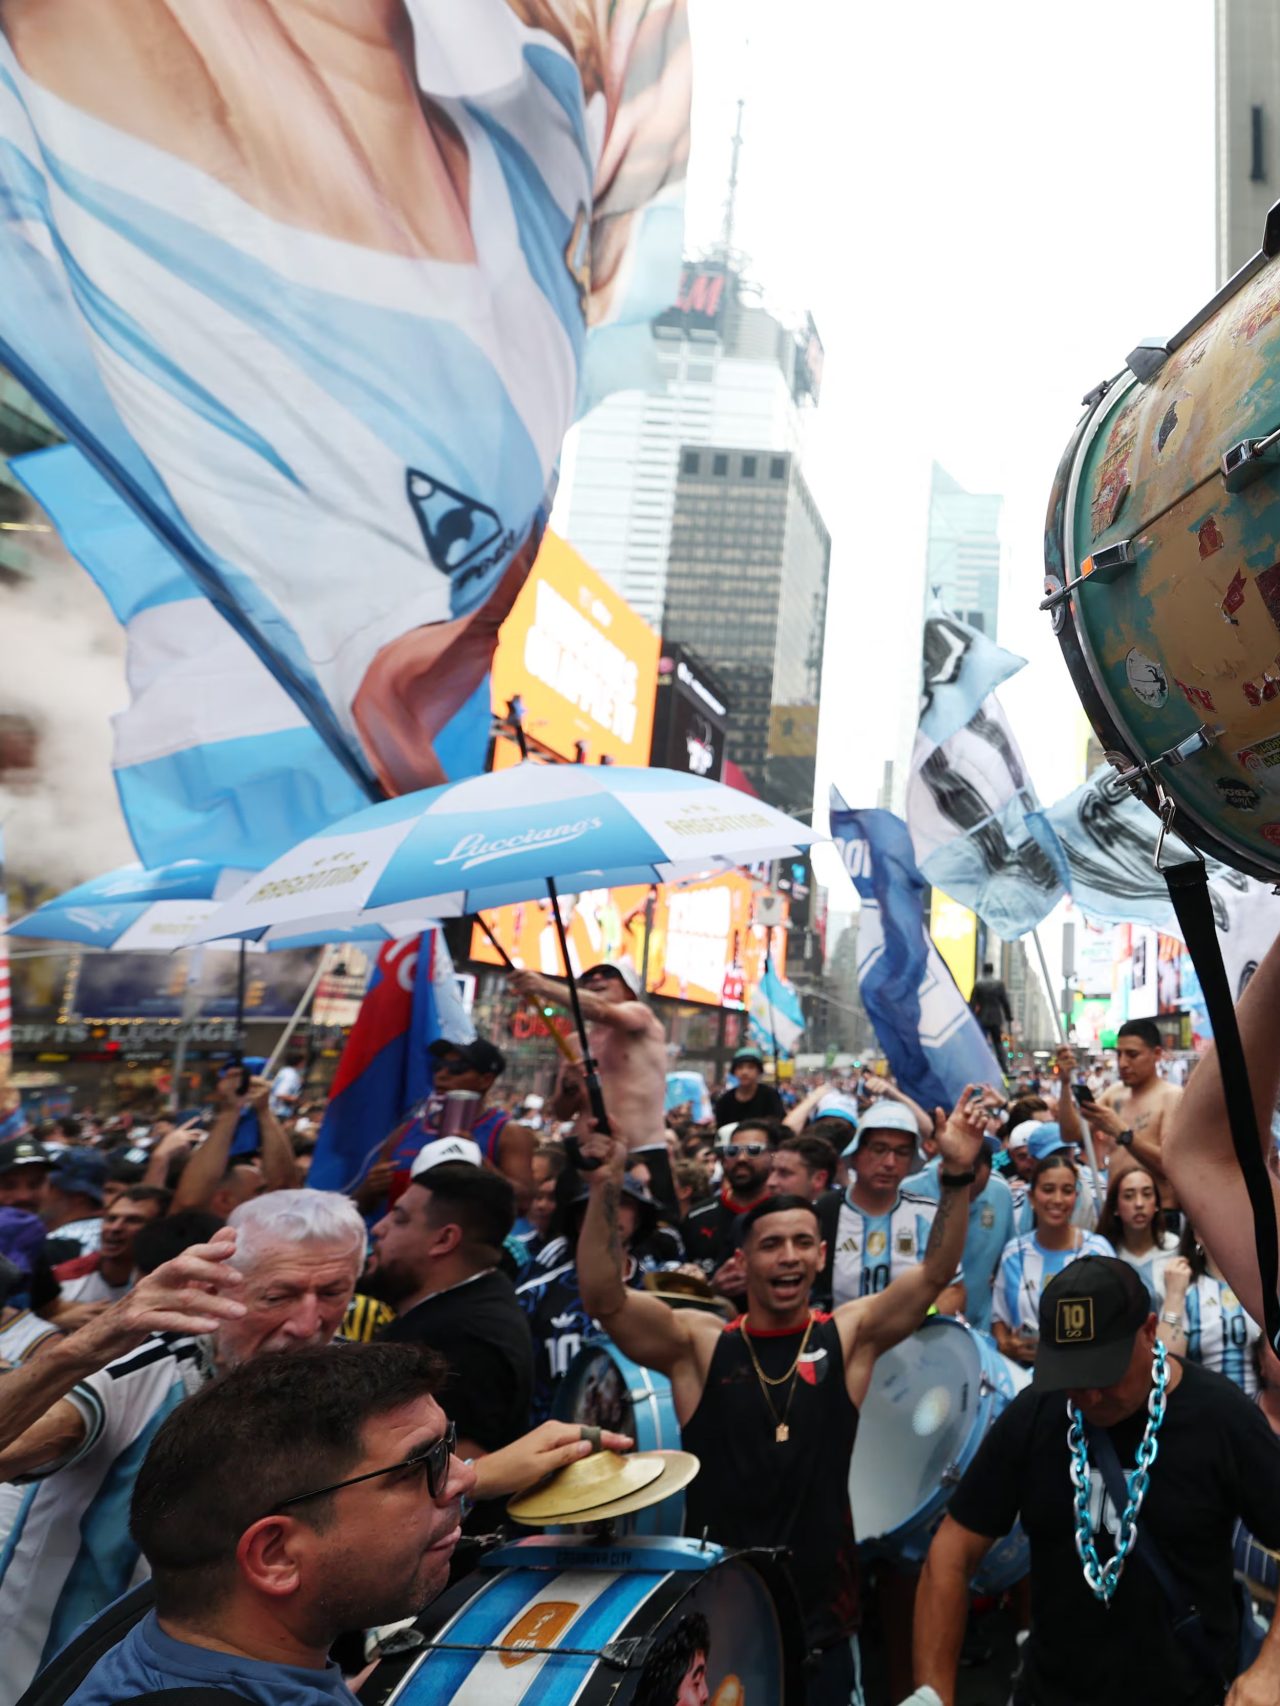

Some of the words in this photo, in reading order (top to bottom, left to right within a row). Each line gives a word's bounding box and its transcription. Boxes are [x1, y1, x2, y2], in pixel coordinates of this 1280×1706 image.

[433, 814, 604, 869] Lucciano's
[1063, 1305, 1085, 1330] 10
[1220, 1315, 1247, 1346] 10
[544, 1333, 581, 1379] 10
[610, 1552, 632, 1566] CITY
